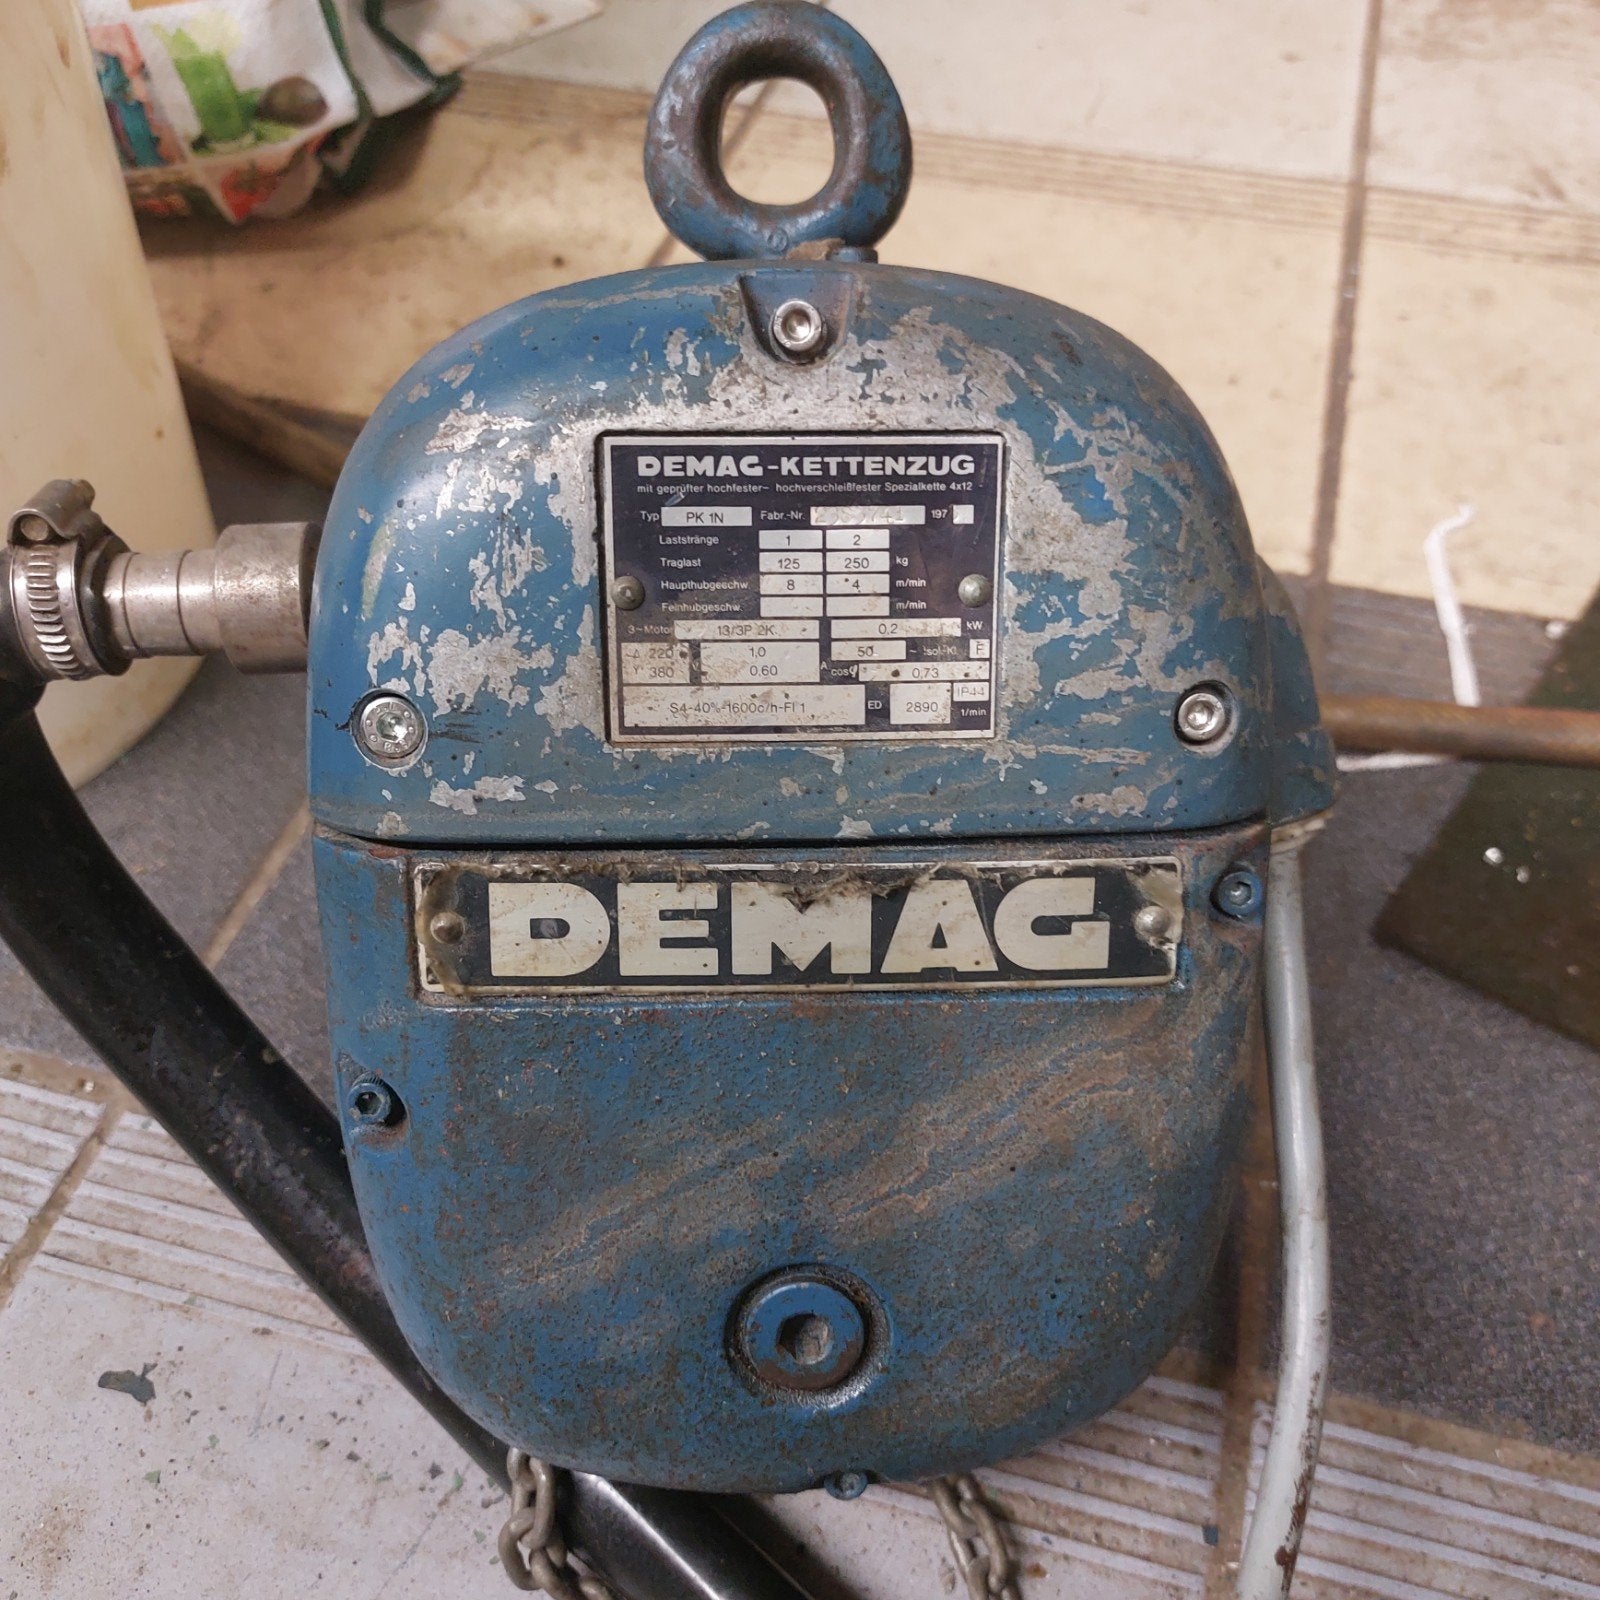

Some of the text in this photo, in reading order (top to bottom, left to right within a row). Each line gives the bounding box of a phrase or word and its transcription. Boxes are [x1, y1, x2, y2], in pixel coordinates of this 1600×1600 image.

[637, 454, 975, 477] DEMAG-KETTENZUG
[637, 483, 653, 493] mit
[657, 483, 704, 495] geprüfter
[775, 481, 882, 493] hochverschleißfester
[884, 481, 947, 493] Spezialkette
[949, 481, 973, 491] 4x12
[640, 510, 660, 521] Typ
[686, 511, 724, 524] PK 1N
[760, 510, 806, 521] Fabr.-Nr.
[930, 508, 949, 520] 197
[659, 534, 720, 547] Laststränge
[784, 535, 792, 547] 1
[852, 534, 862, 546] 2
[660, 557, 702, 570] Traglast
[777, 558, 801, 570] 125
[844, 557, 870, 570] 250
[895, 555, 909, 567] kg
[786, 579, 796, 591] 8
[851, 579, 861, 590] 4
[895, 578, 927, 588] m/min
[661, 602, 744, 614] Feinhubgeschw.
[895, 600, 927, 610] m/min
[966, 620, 983, 631] kW
[649, 648, 674, 659] 220
[857, 645, 874, 658] 50
[820, 661, 828, 670] A
[649, 666, 675, 678] 380
[867, 700, 883, 710] ED
[906, 701, 939, 713] 2890
[488, 876, 1111, 977] DEMAG
